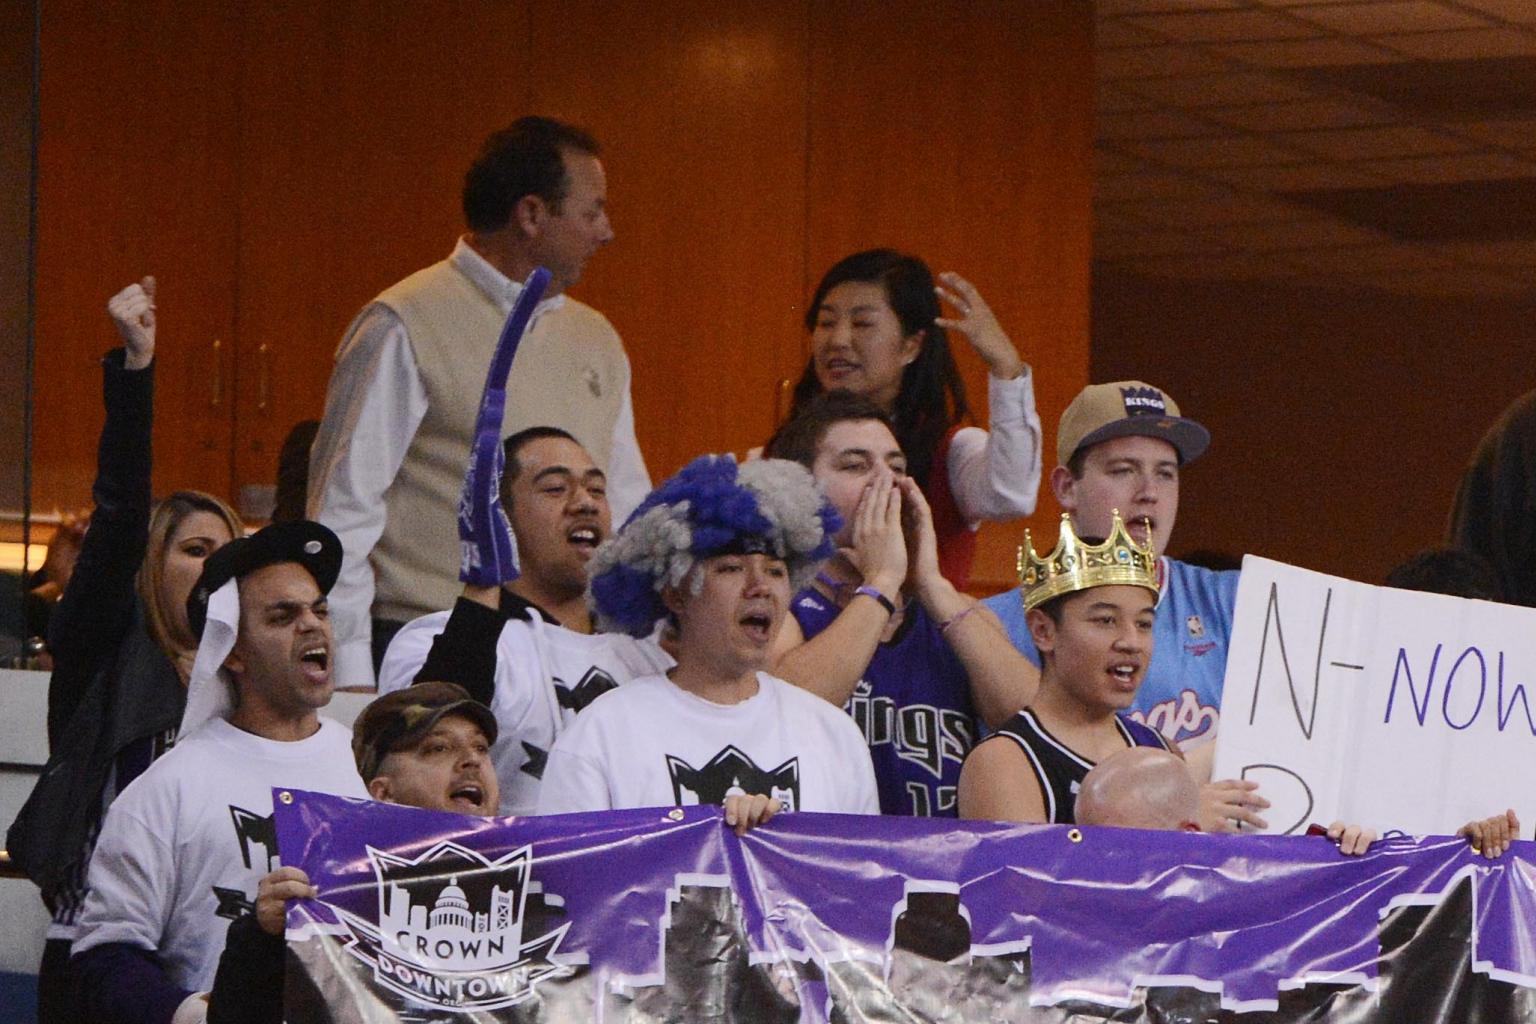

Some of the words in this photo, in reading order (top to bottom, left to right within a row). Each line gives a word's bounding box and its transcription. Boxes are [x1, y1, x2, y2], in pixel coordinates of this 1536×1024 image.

[1125, 396, 1164, 410] KINGS
[843, 679, 975, 780] ings
[396, 930, 505, 960] CROWN
[377, 950, 530, 1001] DOWNTOWN
